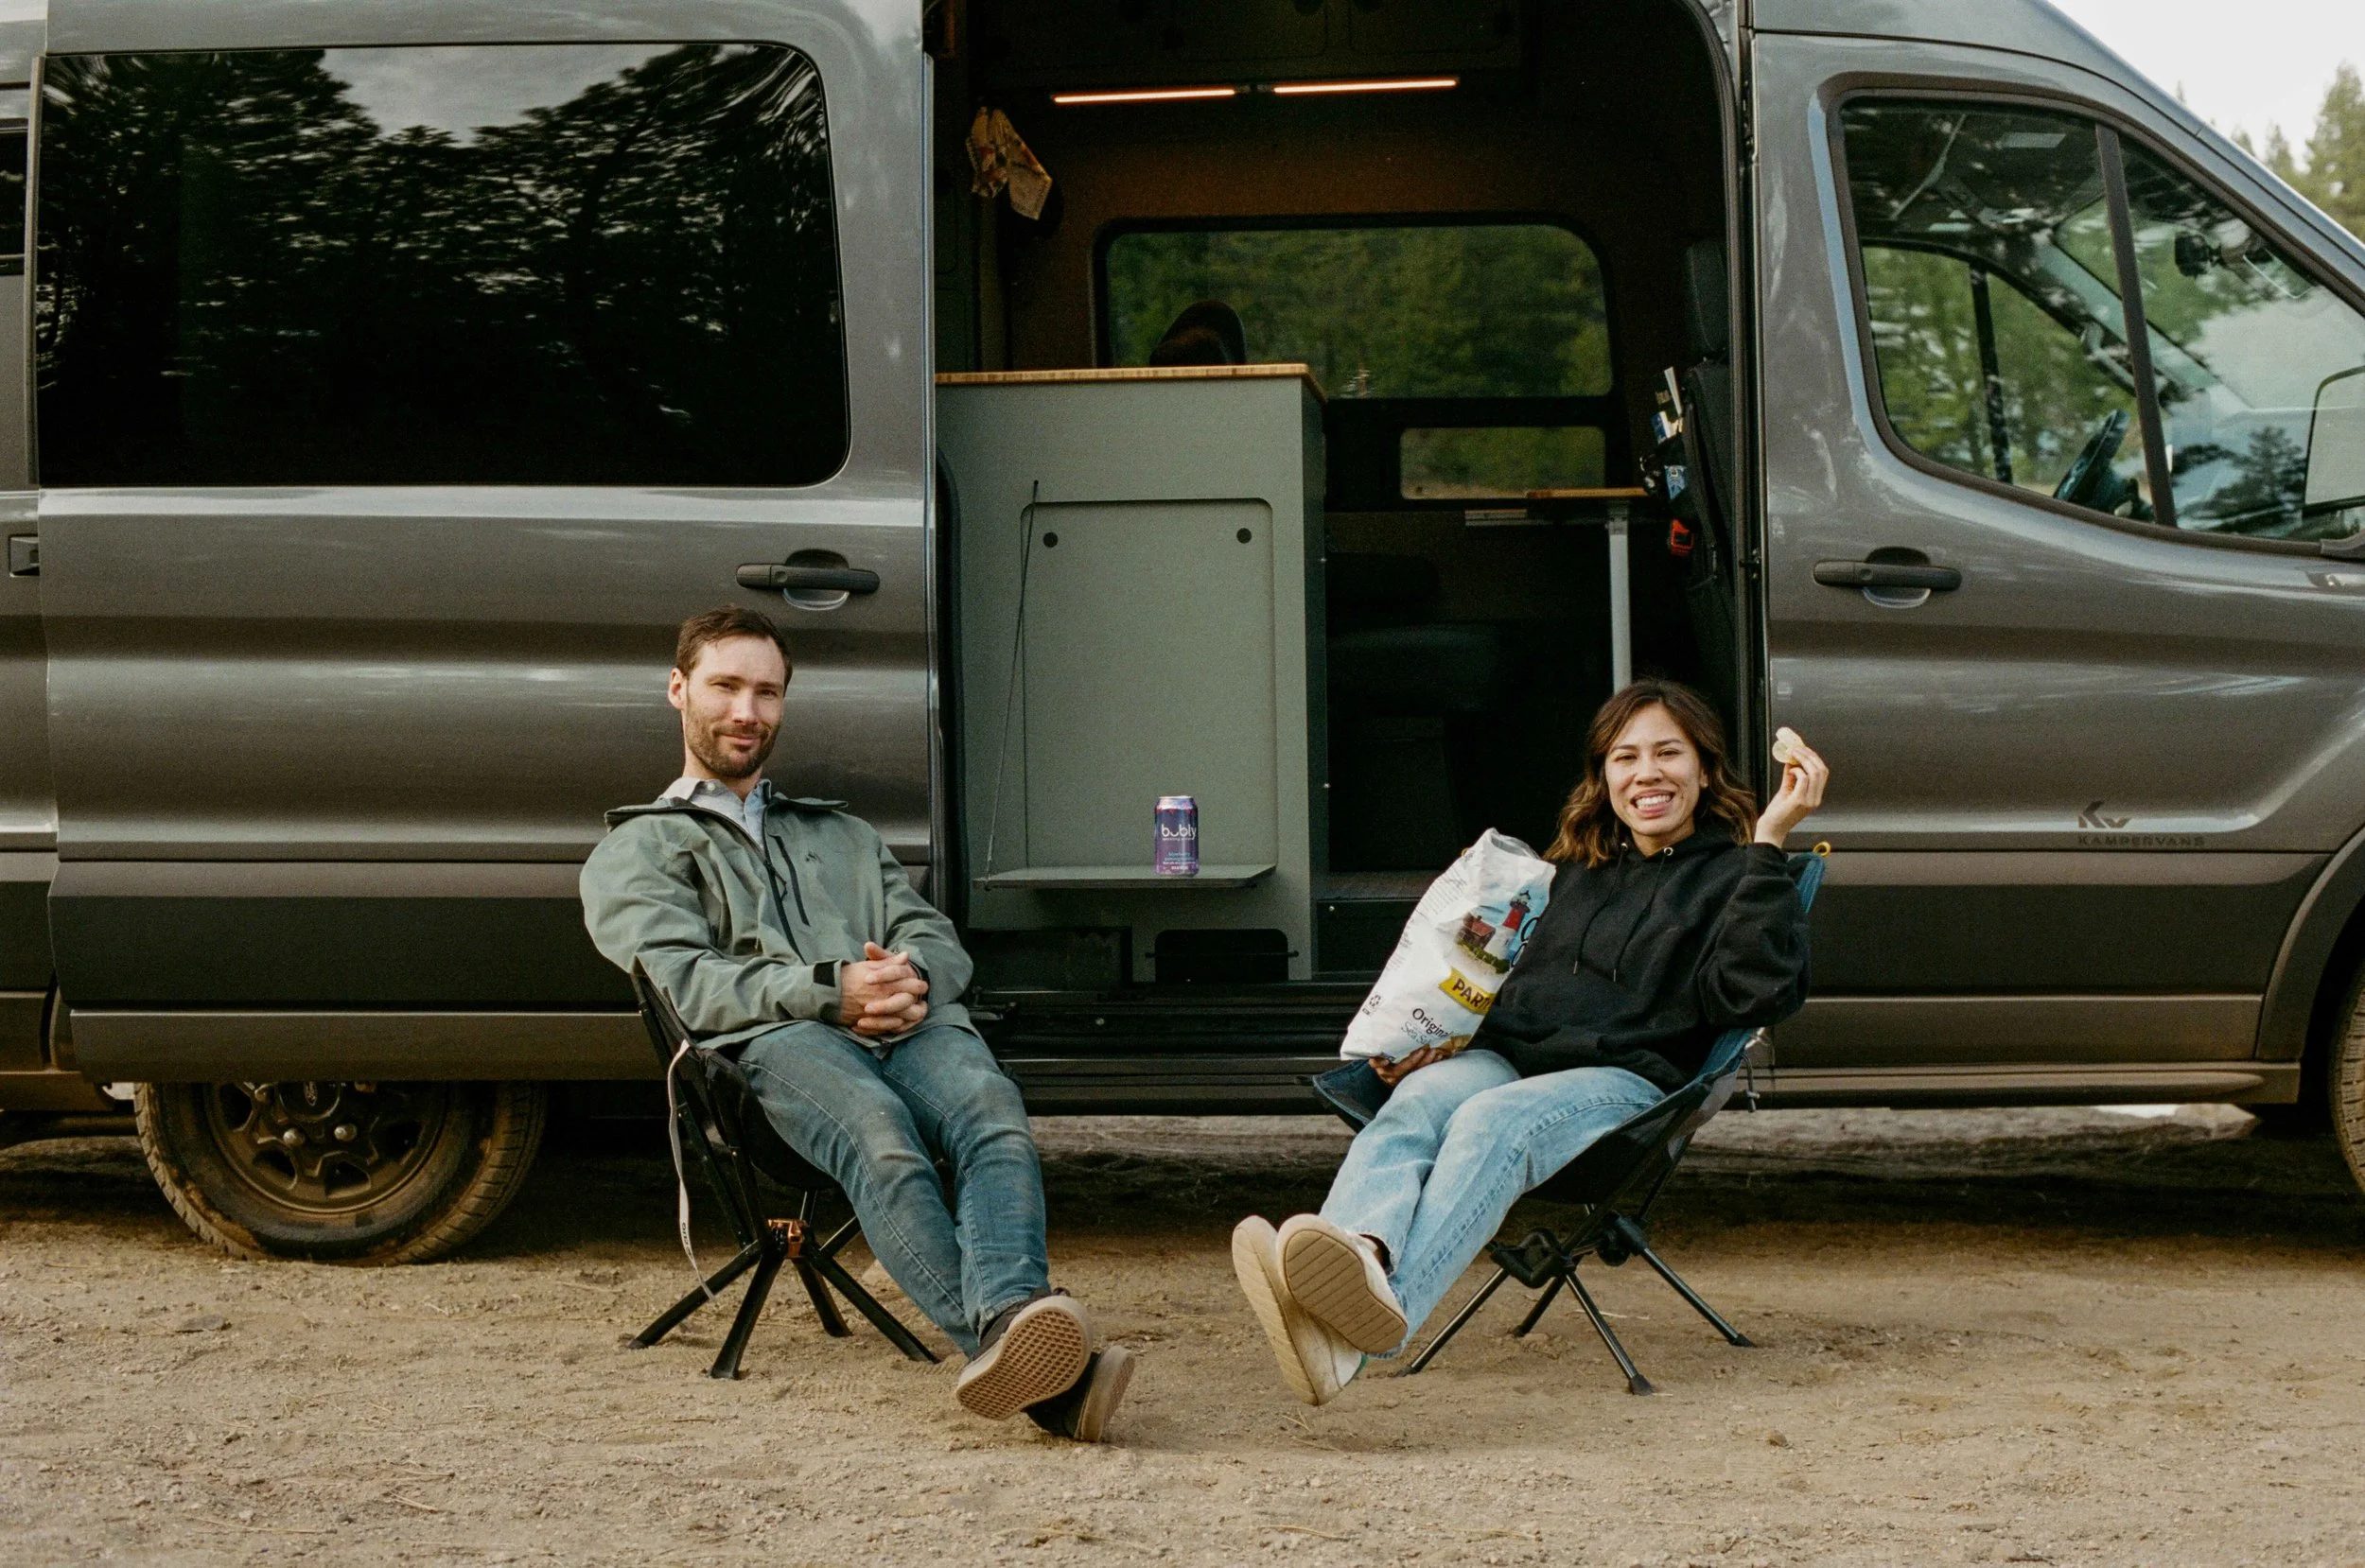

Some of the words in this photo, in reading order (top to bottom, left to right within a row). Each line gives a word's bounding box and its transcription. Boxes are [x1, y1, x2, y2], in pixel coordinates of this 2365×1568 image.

[1161, 824, 1197, 840] bubly
[2078, 835, 2205, 846] KAMPERVANS
[1416, 1034, 1433, 1046] Sal
